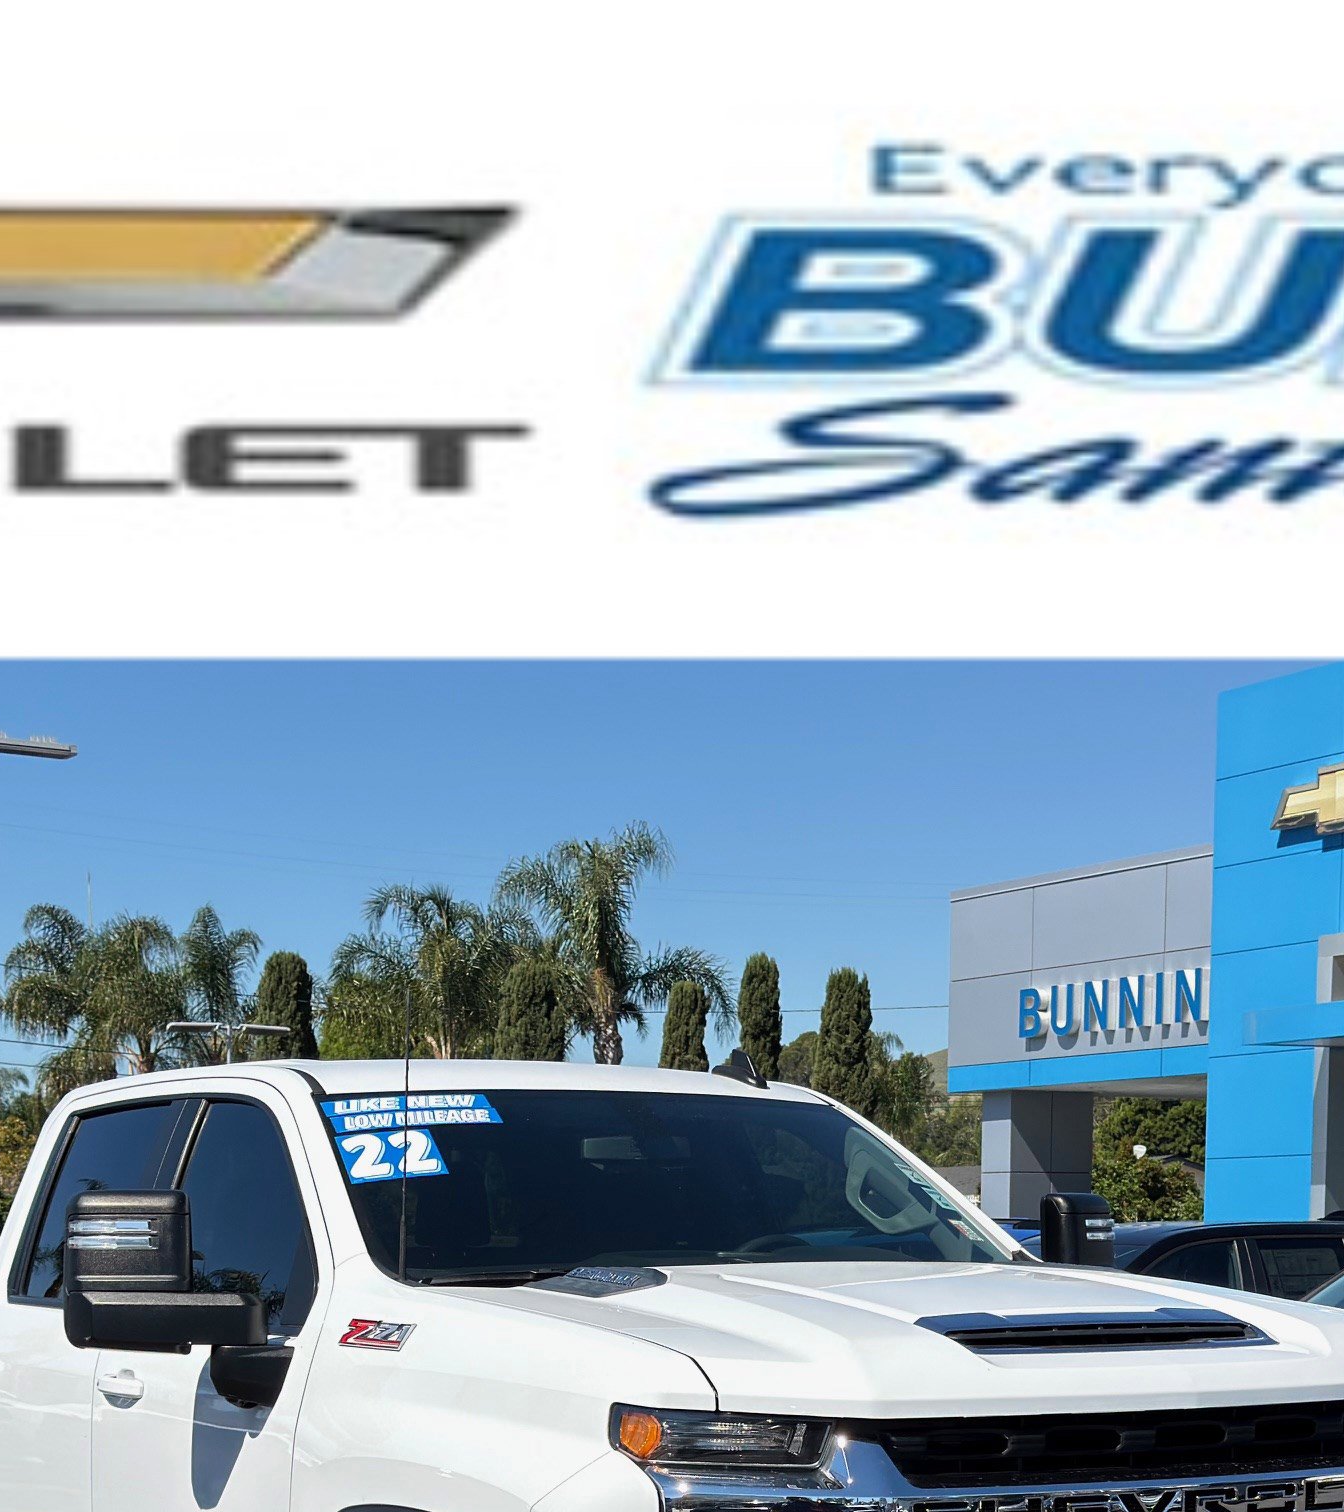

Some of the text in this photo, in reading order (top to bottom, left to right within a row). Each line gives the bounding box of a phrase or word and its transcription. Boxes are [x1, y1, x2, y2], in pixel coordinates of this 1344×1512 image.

[1019, 967, 1210, 1038] BUNNIN
[334, 1095, 476, 1114] LIKE NEW
[344, 1109, 491, 1130] LOW MILEAGE
[341, 1130, 441, 1179] 22
[339, 1318, 417, 1352] Z71
